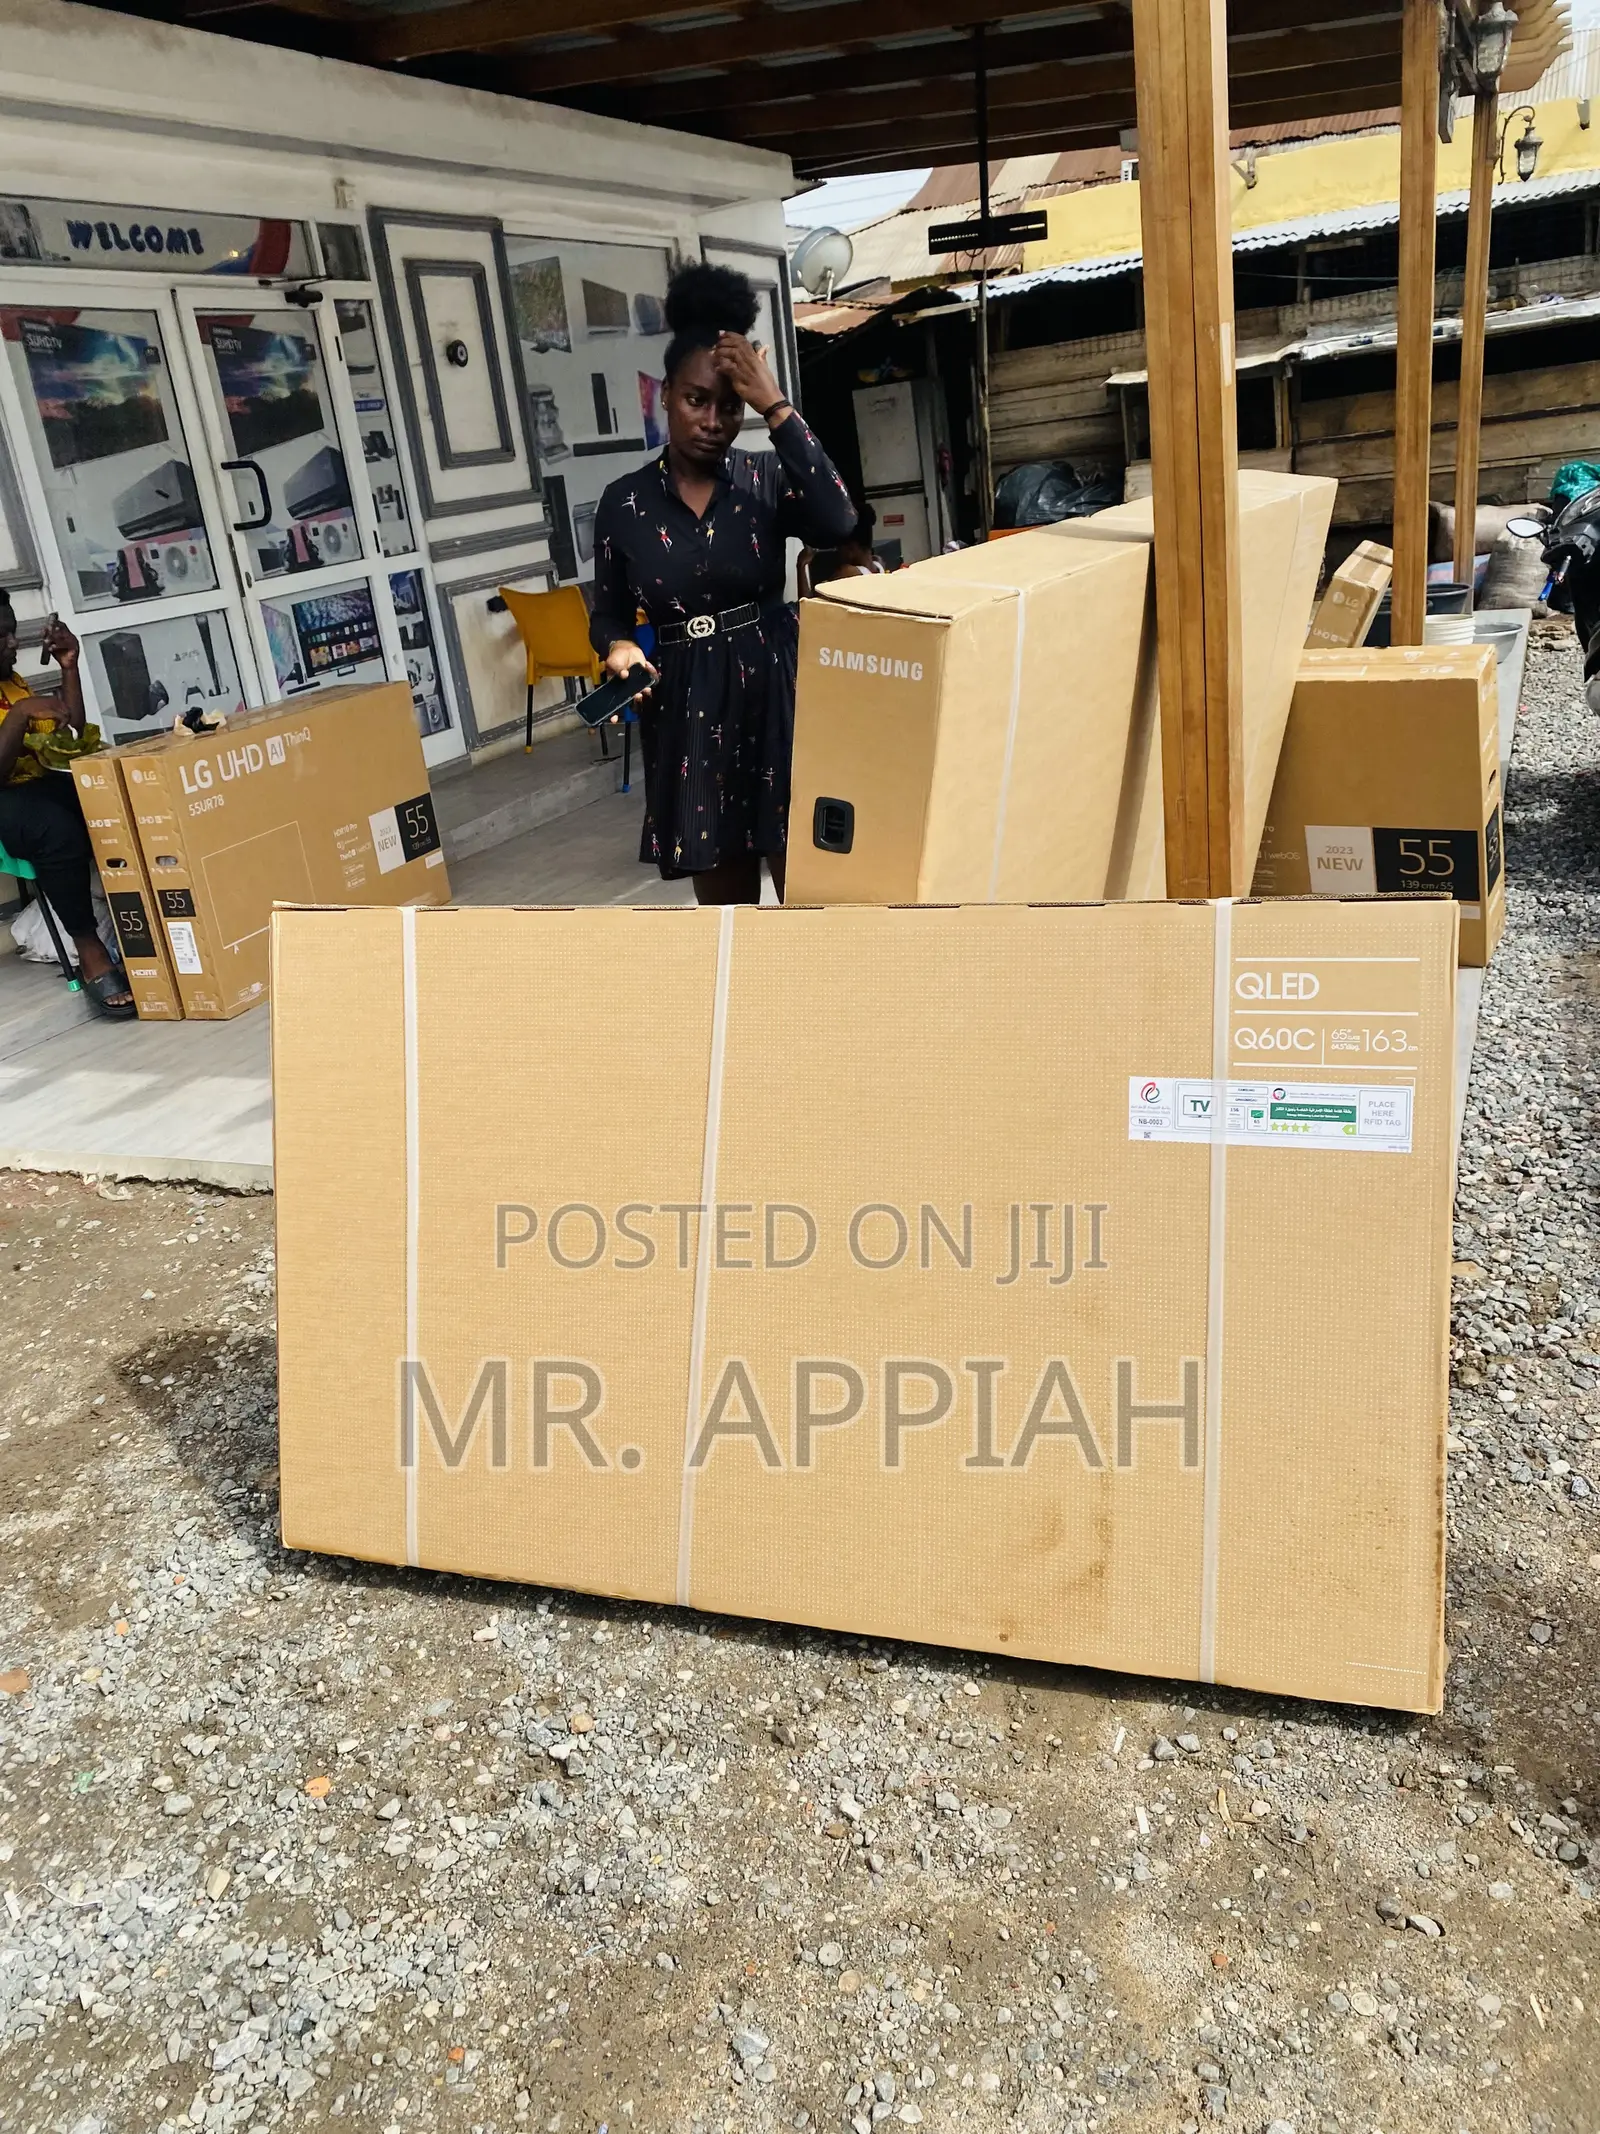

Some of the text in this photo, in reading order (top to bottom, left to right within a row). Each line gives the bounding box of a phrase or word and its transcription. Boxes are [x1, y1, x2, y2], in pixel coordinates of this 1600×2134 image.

[66, 219, 205, 255] WELCOME
[819, 646, 924, 681] SAMSUNG
[179, 726, 312, 794] LG UHD AI ThinQ
[92, 775, 105, 785] LG
[143, 770, 157, 781] LG
[188, 794, 225, 817] 55UR78
[405, 803, 429, 839] 55
[378, 835, 398, 852] NEW
[1325, 845, 1354, 855] 2023
[1317, 856, 1364, 871] NEW
[1399, 838, 1455, 876] 55
[1401, 879, 1420, 889] 139
[1421, 882, 1435, 890] cm
[166, 891, 186, 909] 55
[120, 910, 143, 932] 55
[1235, 972, 1320, 1000] QLED
[1234, 1027, 1316, 1051] Q60C
[1361, 1029, 1407, 1052] 163
[1190, 1099, 1211, 1112] TV
[1368, 1101, 1396, 1109] PLACE
[1364, 1118, 1383, 1126] RFID
